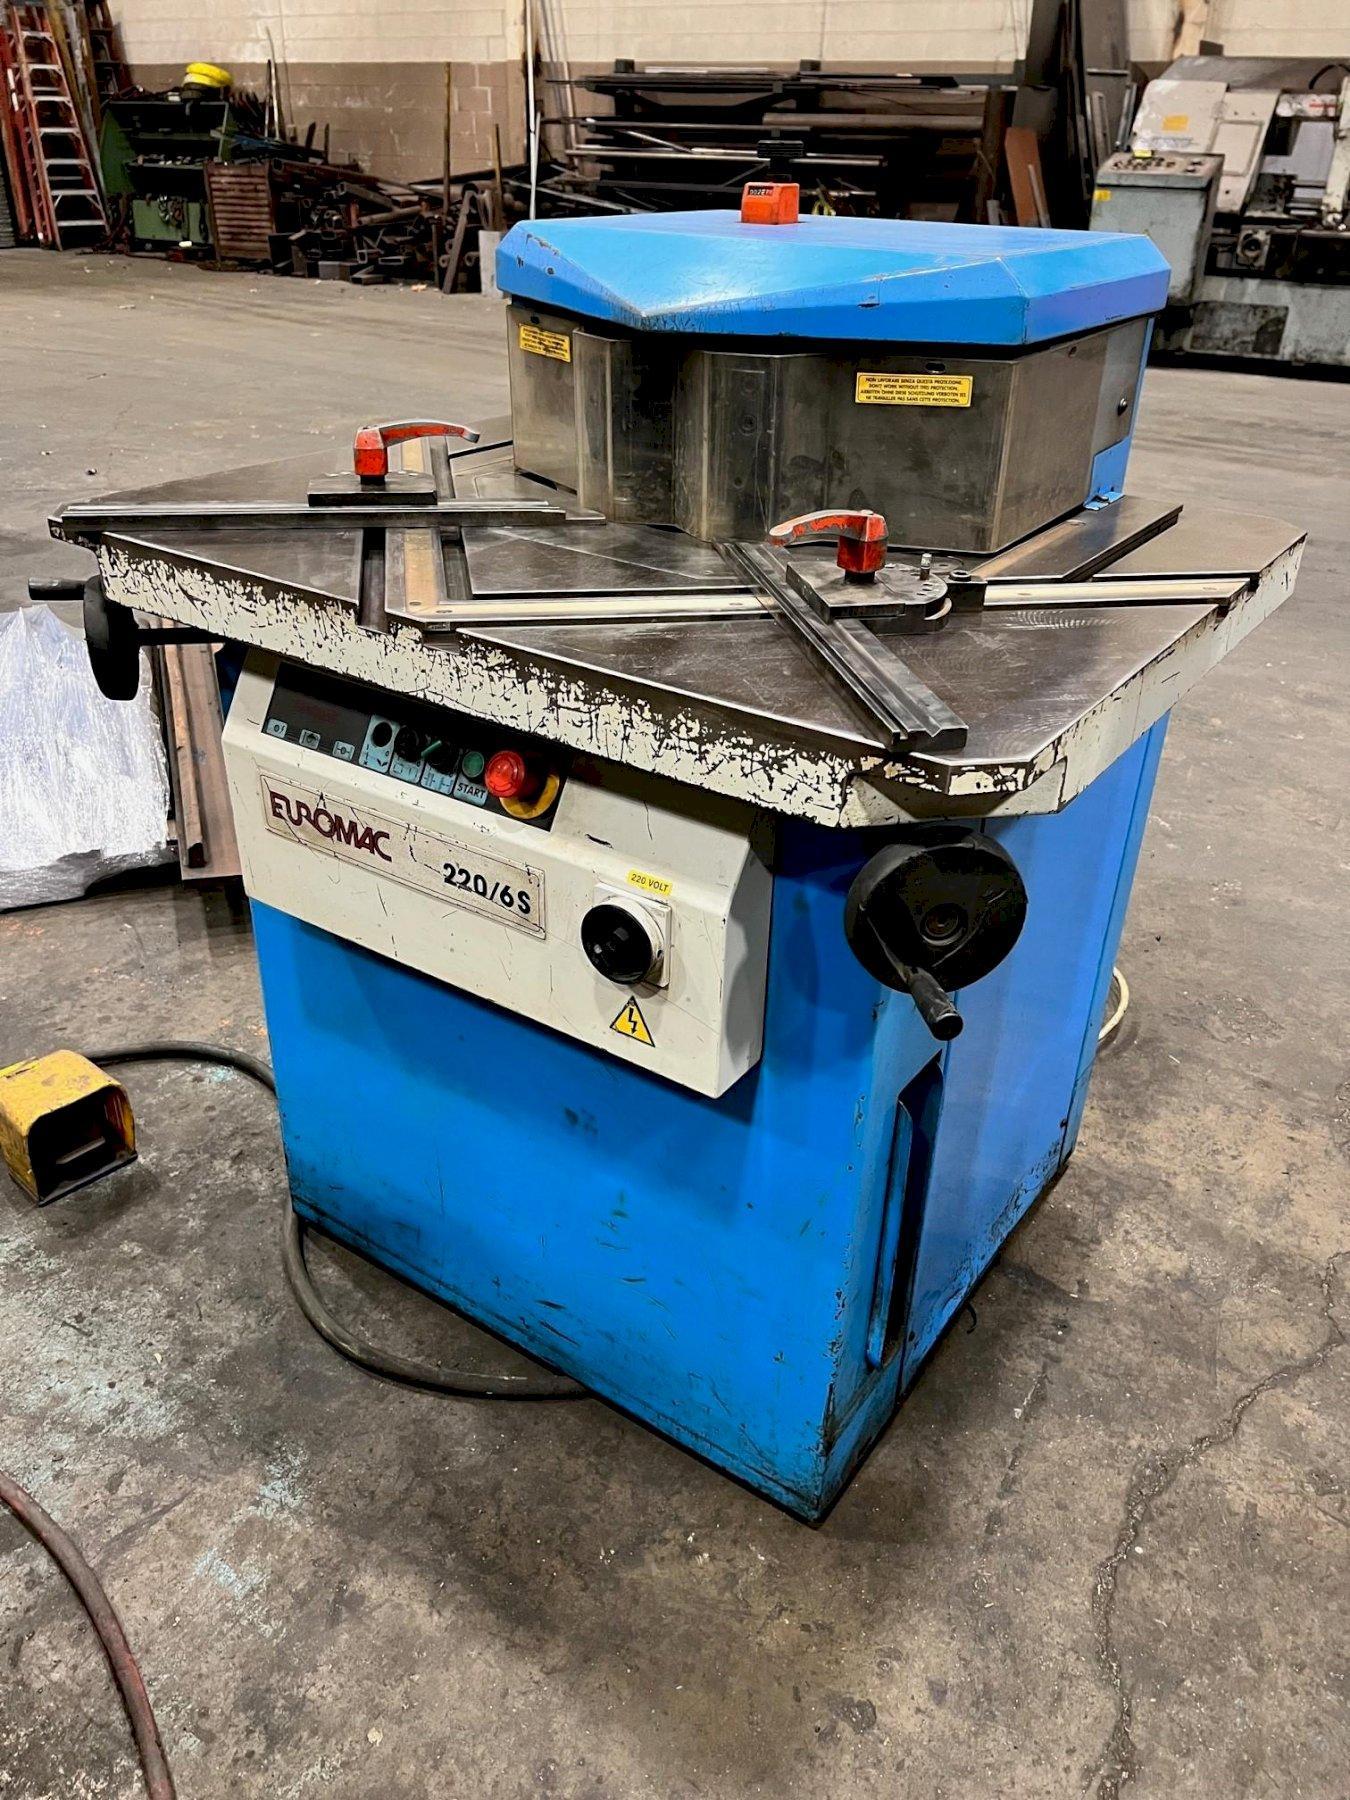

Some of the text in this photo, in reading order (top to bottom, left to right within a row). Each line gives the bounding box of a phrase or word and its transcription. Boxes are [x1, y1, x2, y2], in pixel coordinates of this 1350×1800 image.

[457, 782, 486, 799] START
[269, 790, 392, 862] EUROMAC
[443, 862, 531, 914] 220/6S
[631, 873, 669, 892] 220 VOLT
